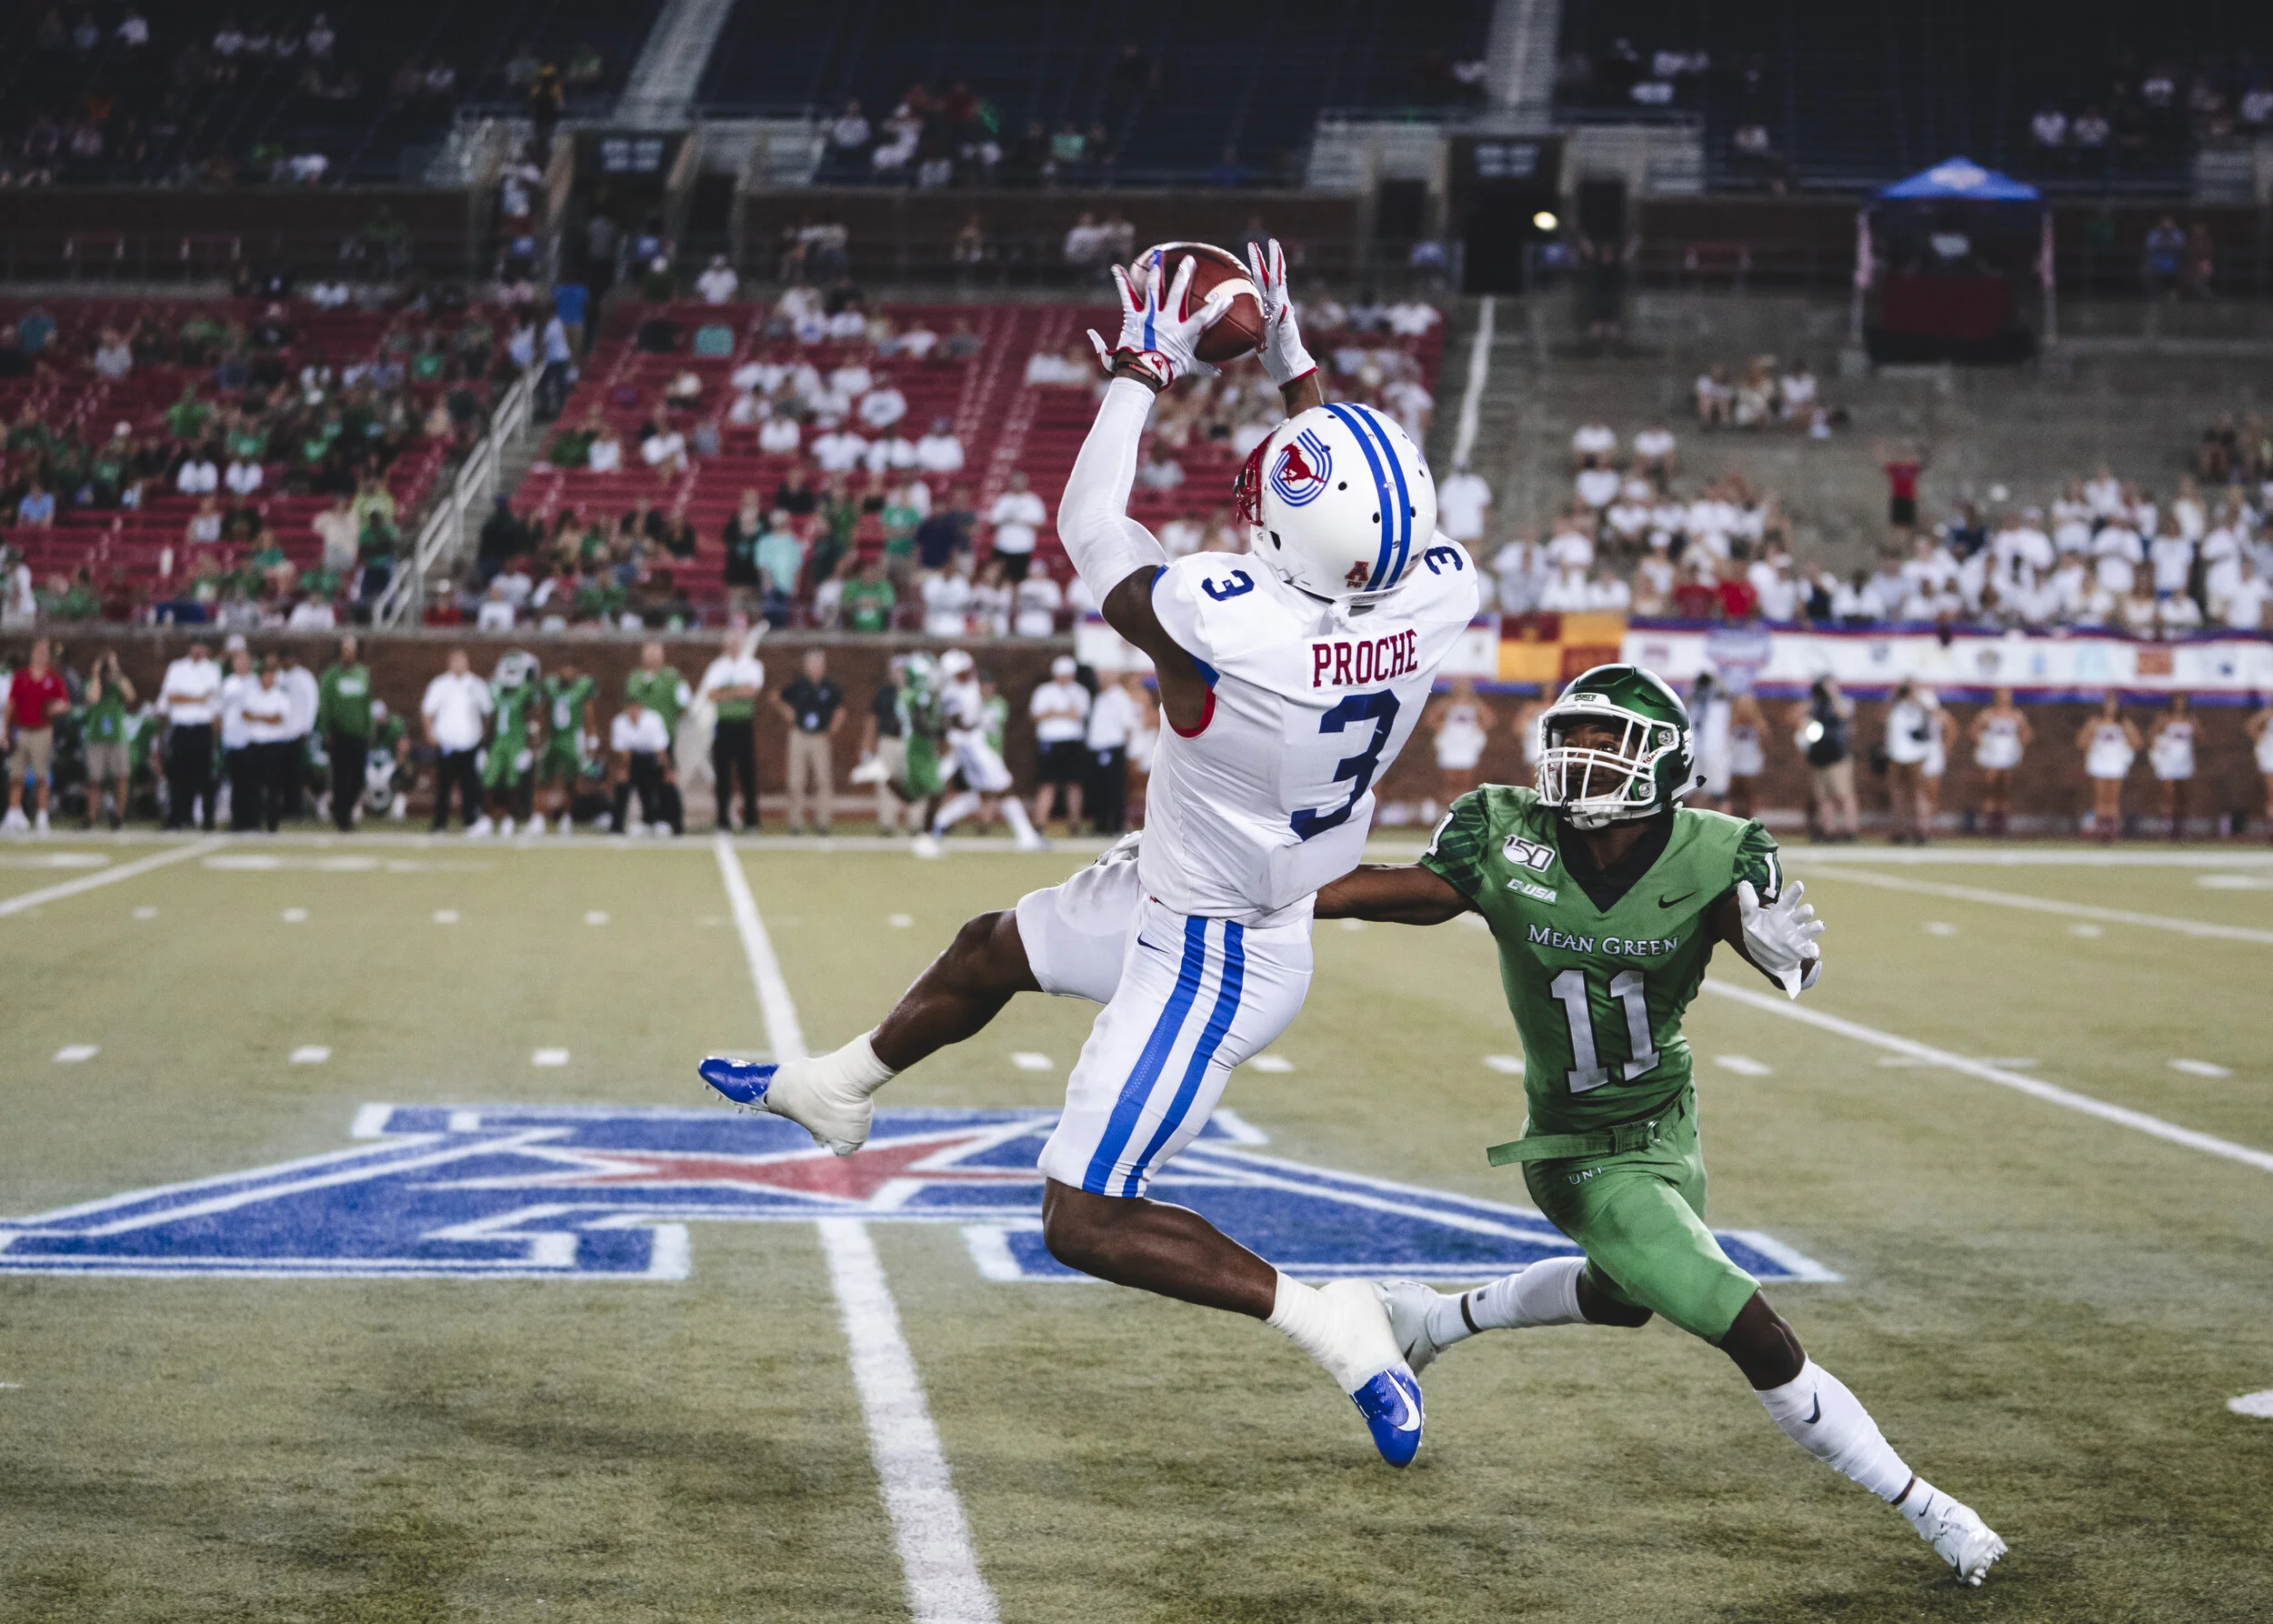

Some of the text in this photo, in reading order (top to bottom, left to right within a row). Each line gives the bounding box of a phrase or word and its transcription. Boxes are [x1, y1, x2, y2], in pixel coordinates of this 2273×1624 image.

[1201, 569, 1255, 602] 3
[1423, 546, 1464, 576] 3
[1312, 628, 1418, 688] PROCHE
[1289, 688, 1401, 842] 3
[1504, 833, 1556, 873] 150
[1549, 968, 1661, 1094] 11
